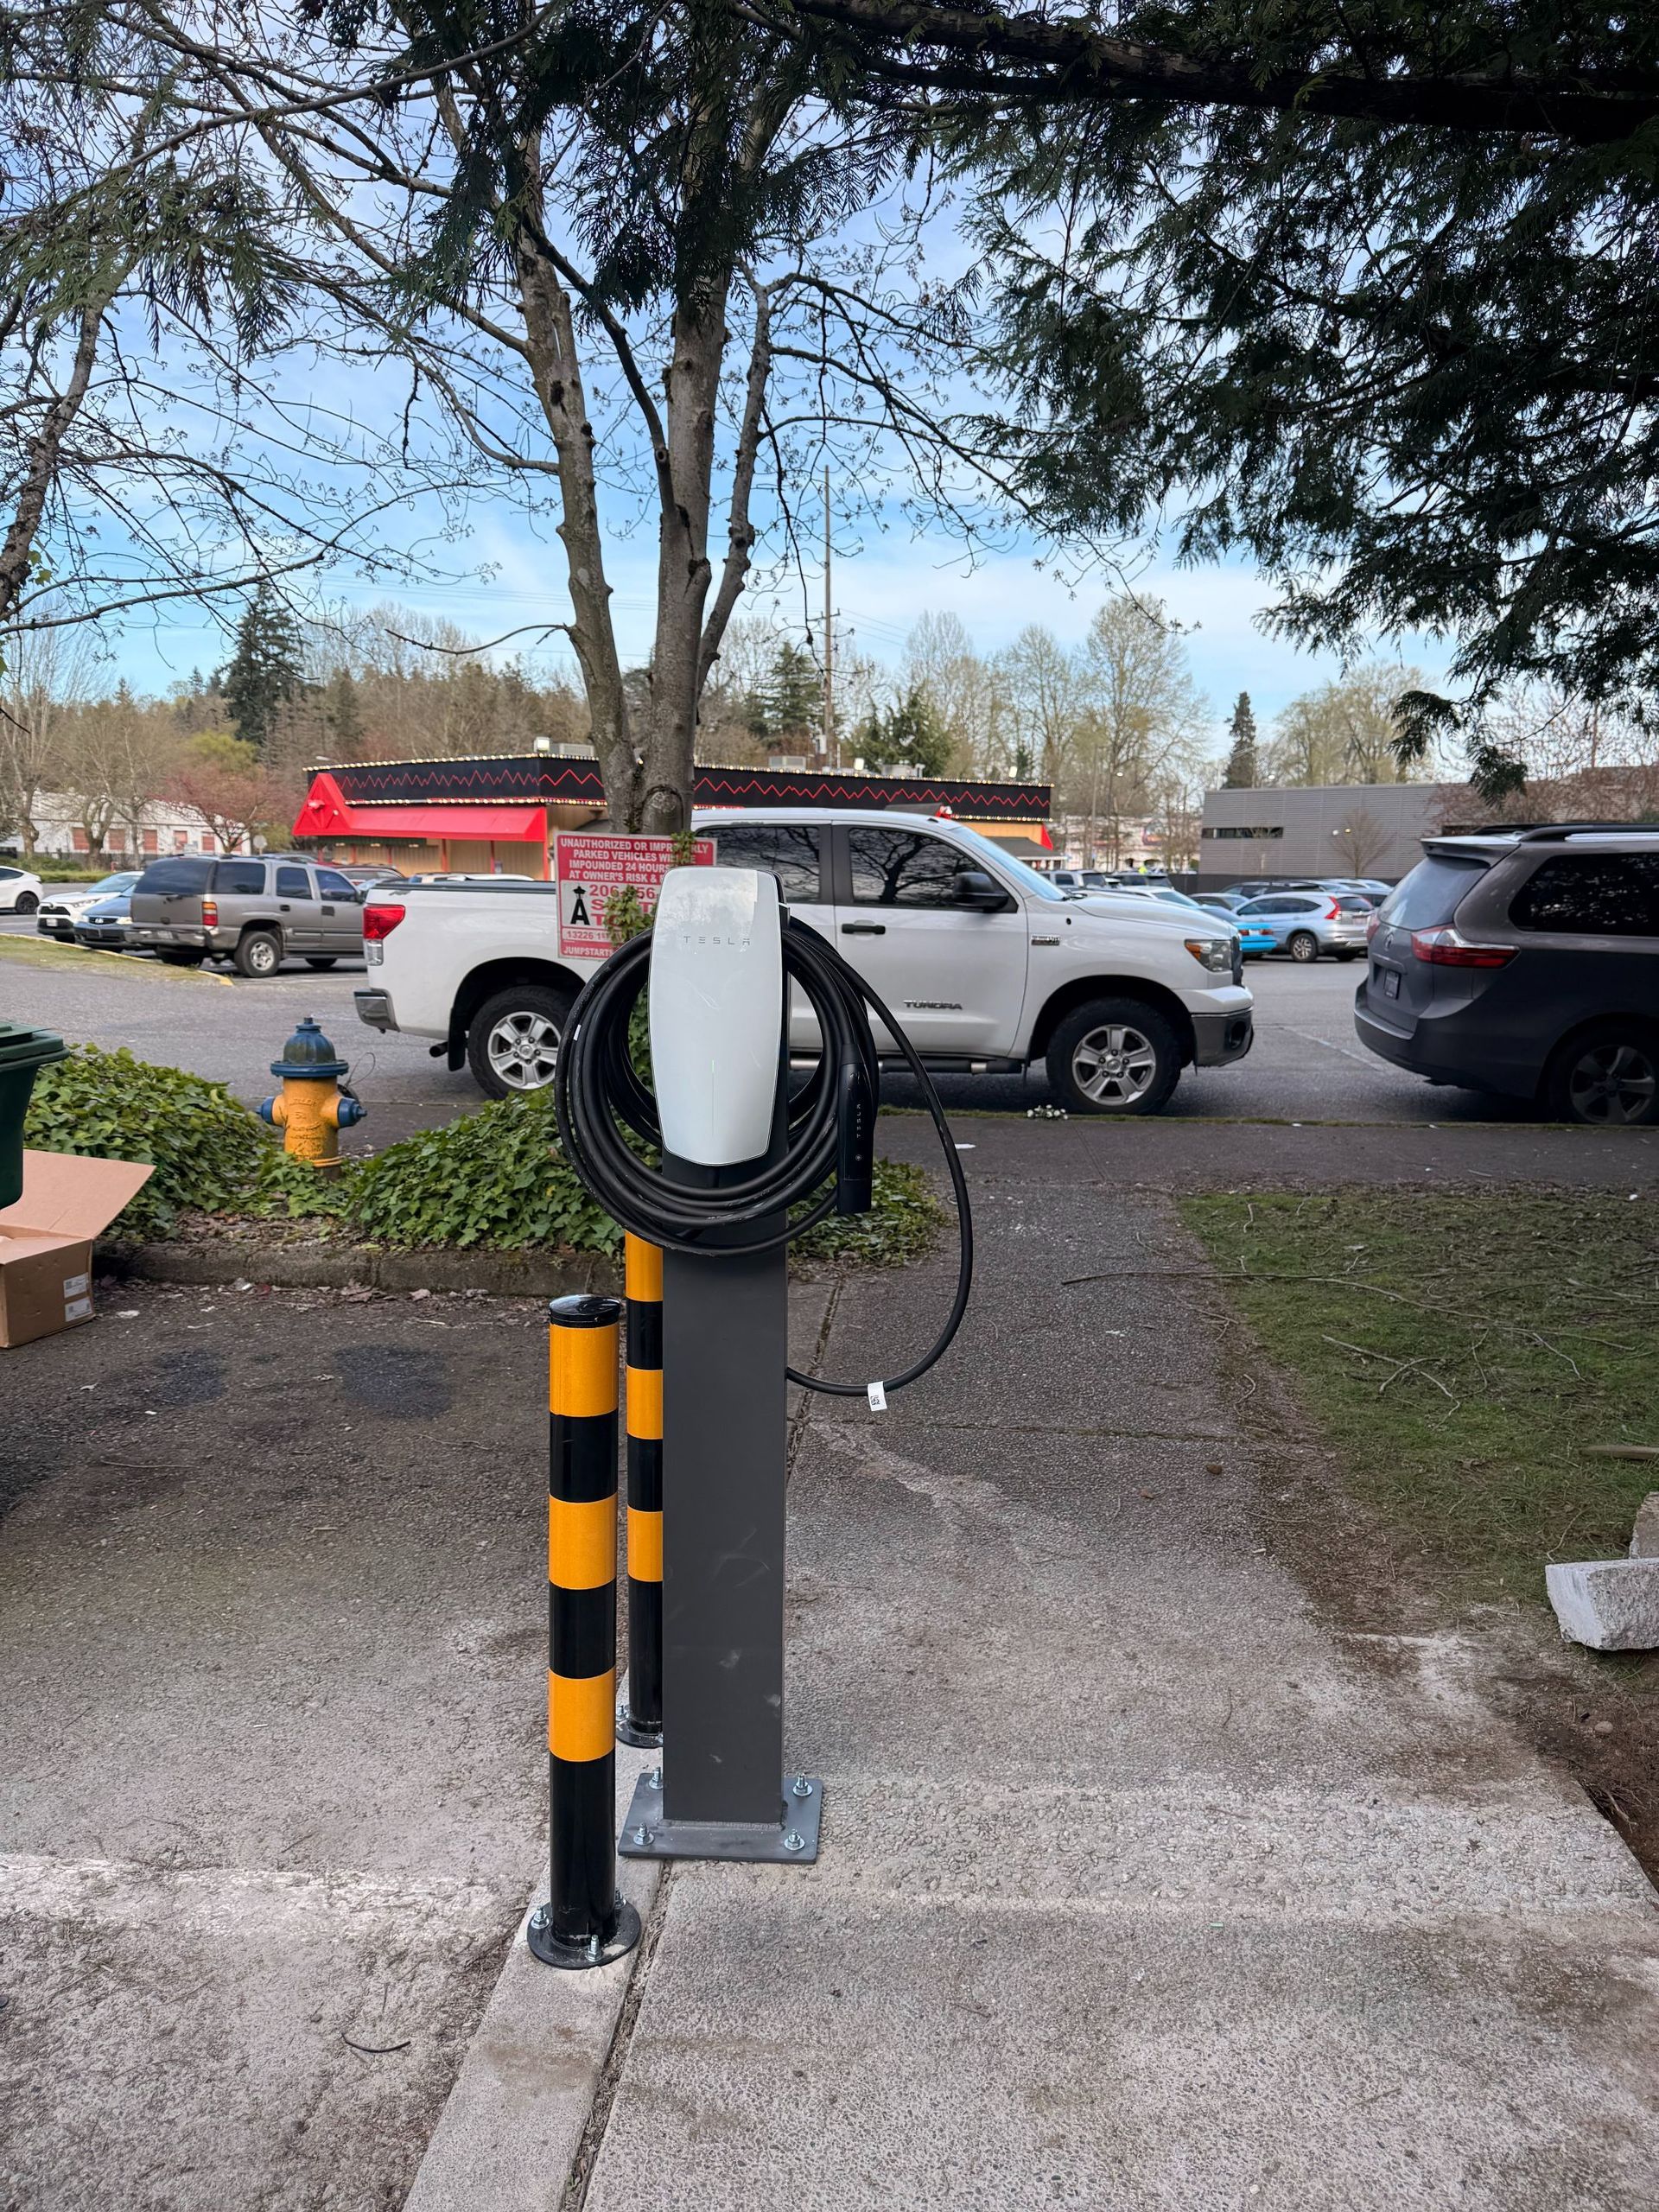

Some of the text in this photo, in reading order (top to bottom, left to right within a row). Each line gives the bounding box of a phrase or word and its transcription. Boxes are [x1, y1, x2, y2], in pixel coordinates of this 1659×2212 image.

[561, 837, 709, 855] UNAUTHORIZED OR IMPRRLY
[574, 849, 609, 860] PARKED
[612, 850, 657, 862] VEHICLES
[569, 859, 623, 871] IMPOUNDED
[626, 861, 637, 872] 24
[569, 869, 581, 880] AT
[583, 871, 623, 881] OWNER'S
[626, 873, 648, 883] RISK
[650, 874, 658, 884] &
[567, 931, 594, 940] 13226
[683, 935, 750, 946] TESLA
[902, 999, 963, 1010] TUNDRA
